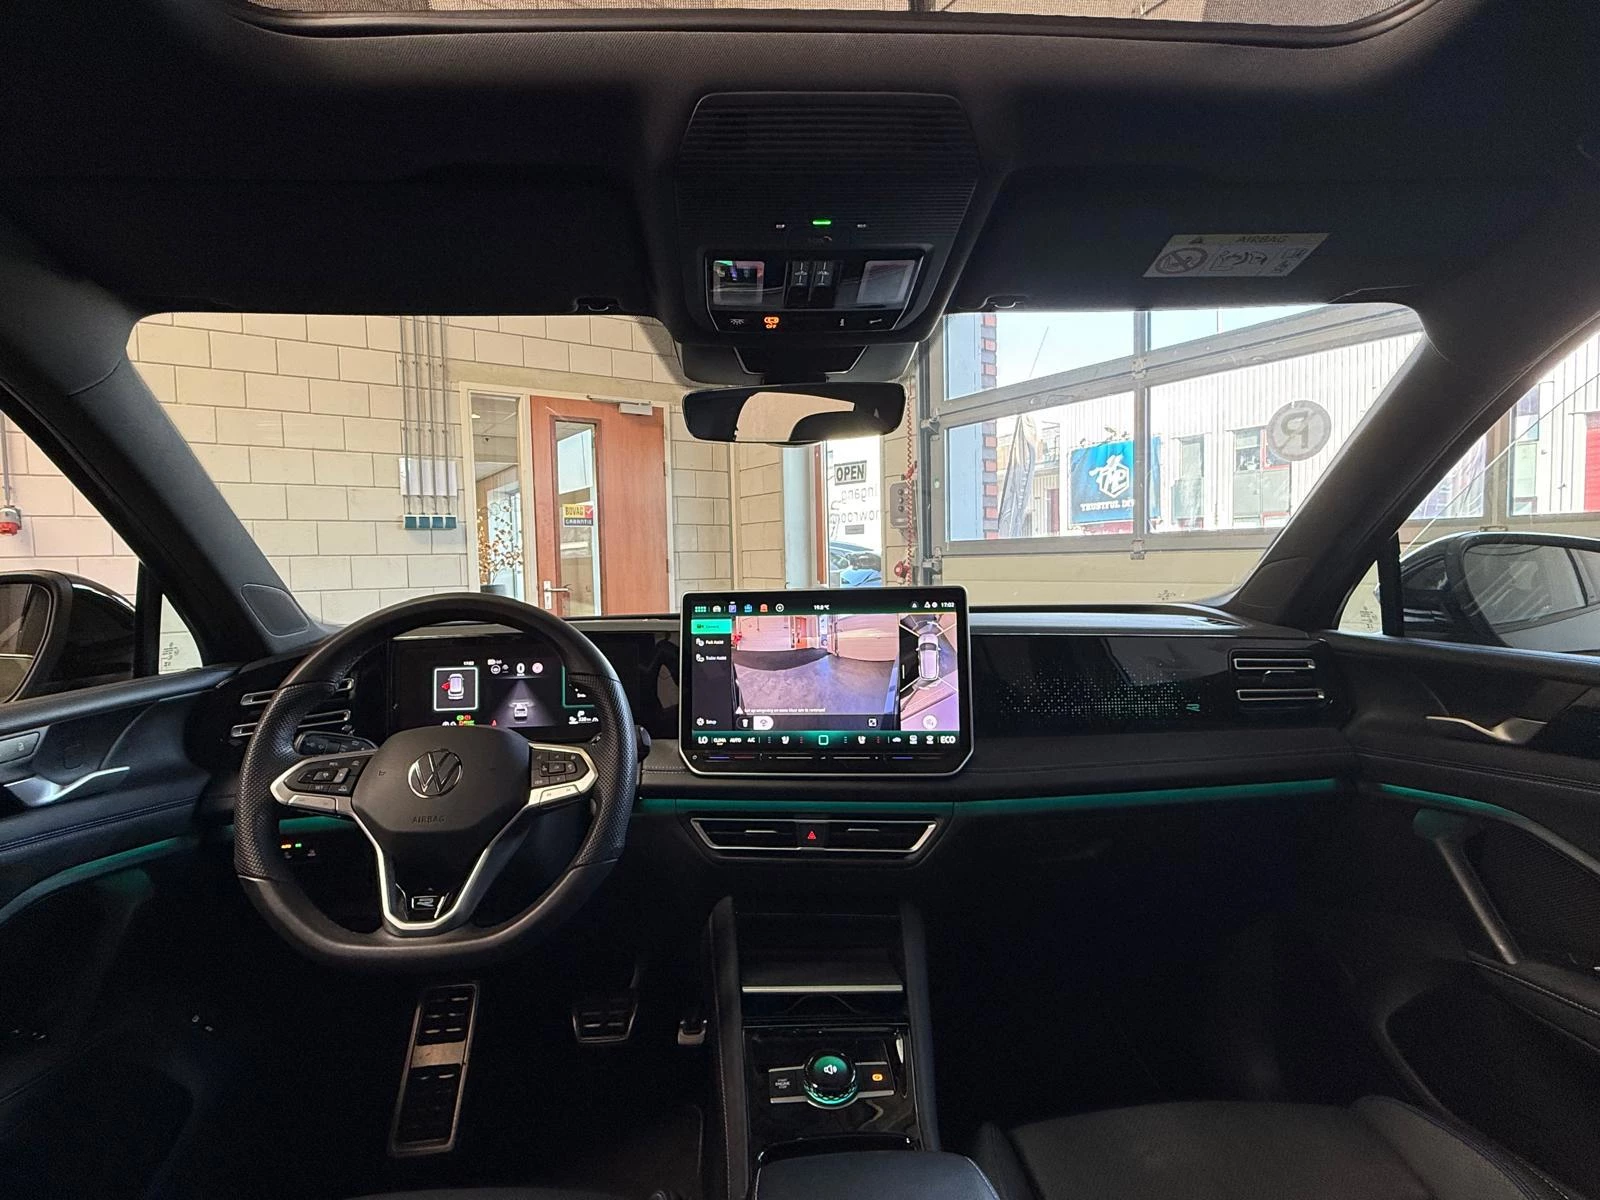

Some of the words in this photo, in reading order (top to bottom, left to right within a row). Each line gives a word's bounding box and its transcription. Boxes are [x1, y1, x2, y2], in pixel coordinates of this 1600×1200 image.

[1235, 235, 1289, 243] AIRBAG
[836, 464, 865, 482] OPEN
[565, 506, 584, 516] BOVAG
[697, 736, 709, 745] LO
[940, 735, 956, 744] ECO
[411, 814, 447, 825] AIRBAG
